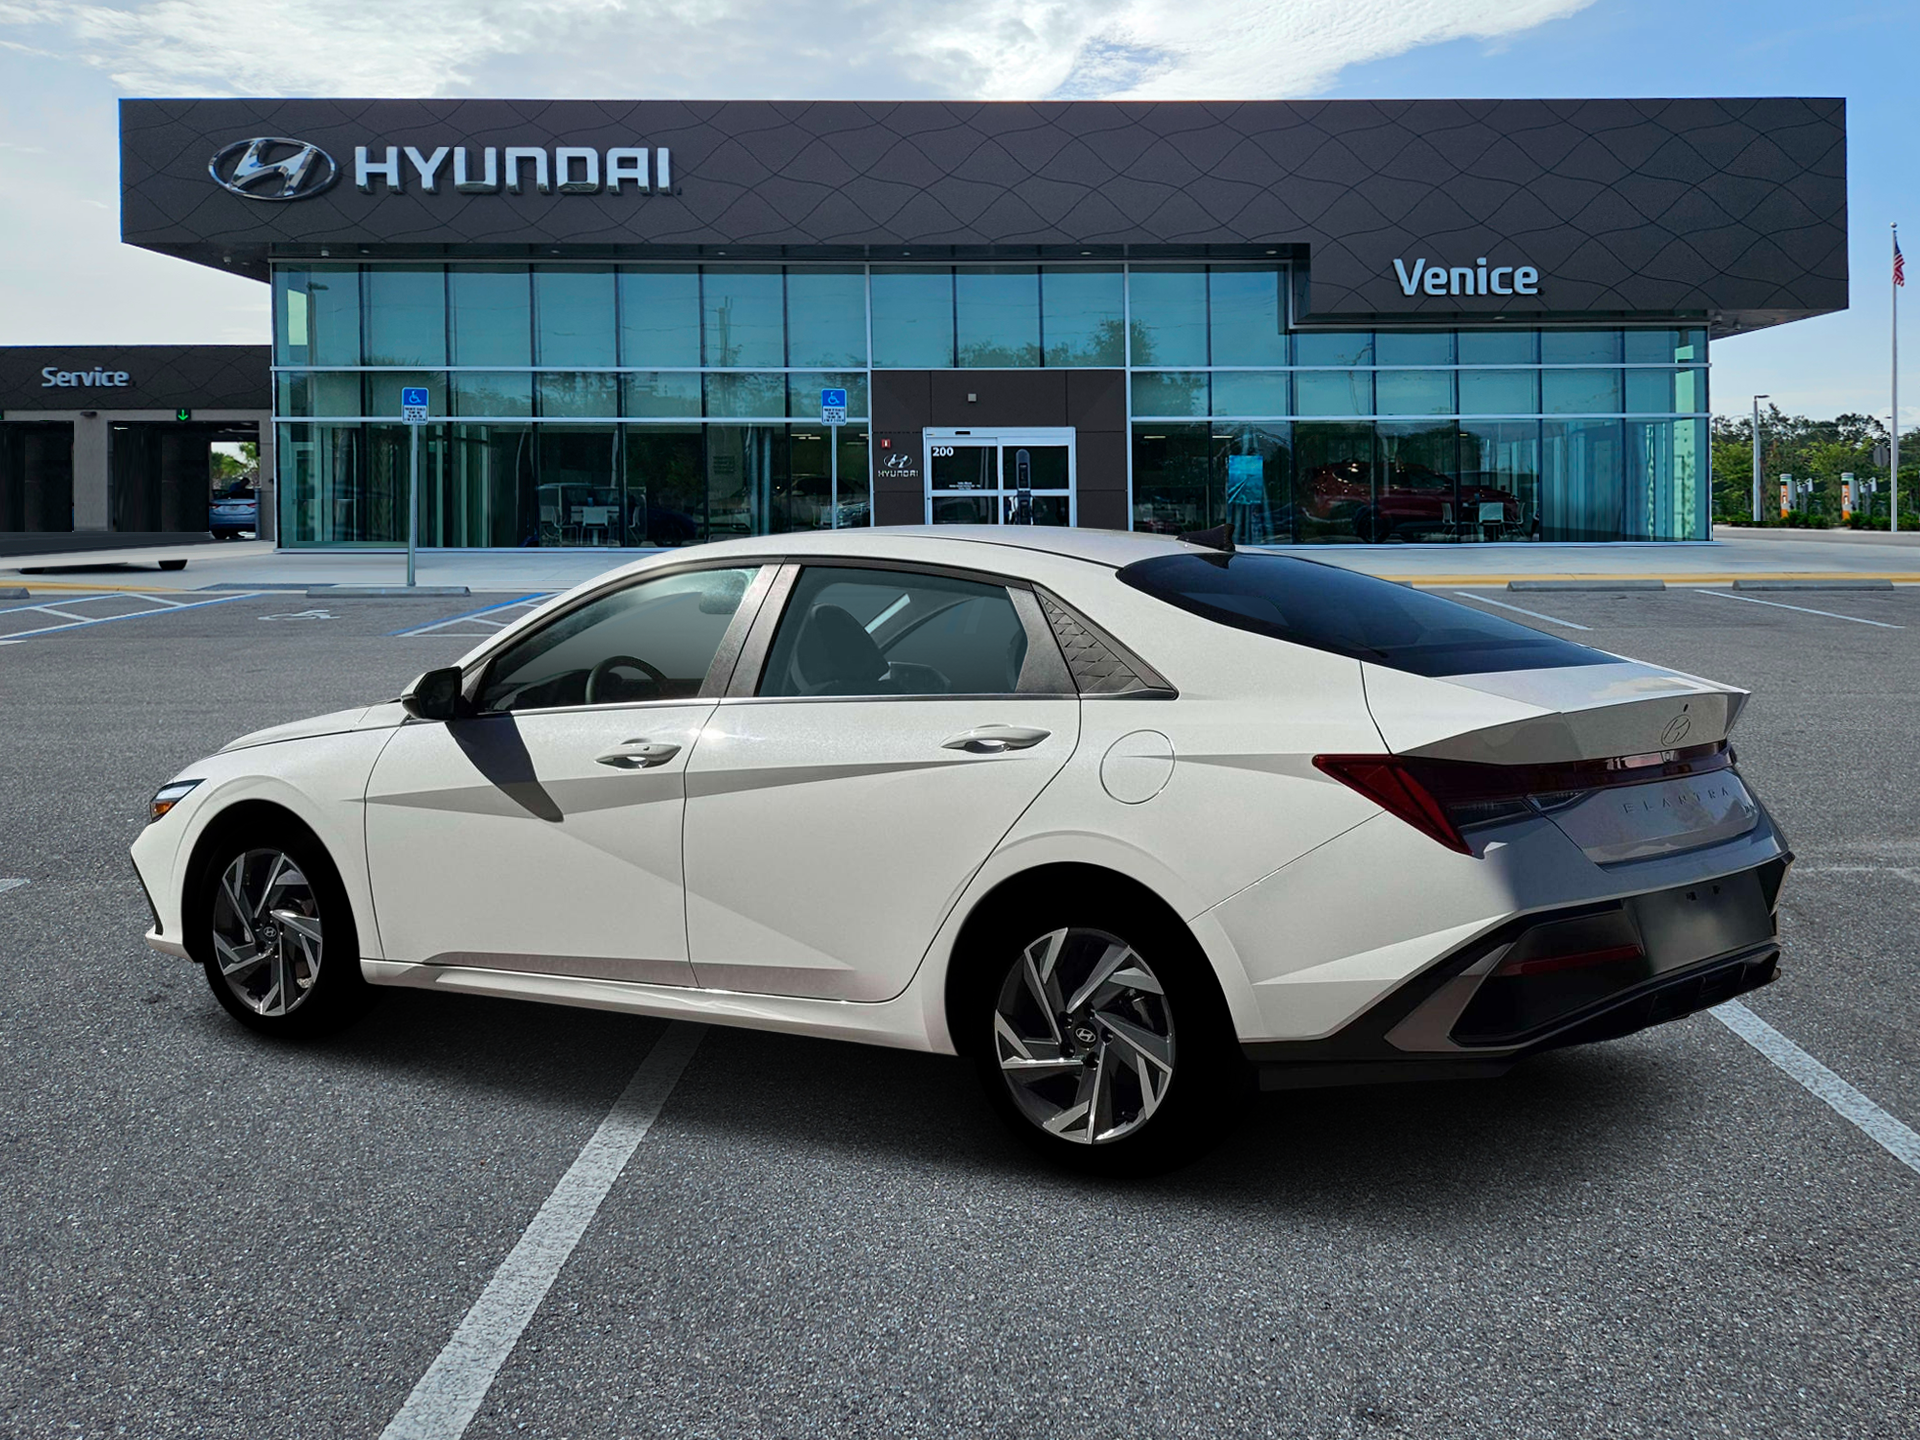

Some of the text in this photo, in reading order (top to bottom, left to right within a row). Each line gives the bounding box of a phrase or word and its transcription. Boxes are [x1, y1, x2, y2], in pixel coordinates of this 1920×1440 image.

[354, 146, 673, 195] HYUNDAI
[1392, 257, 1539, 296] Venice
[41, 366, 130, 387] Service
[932, 447, 954, 457] 200
[877, 470, 919, 478] HYUNDAI
[1622, 786, 1730, 814] ELANTRA
